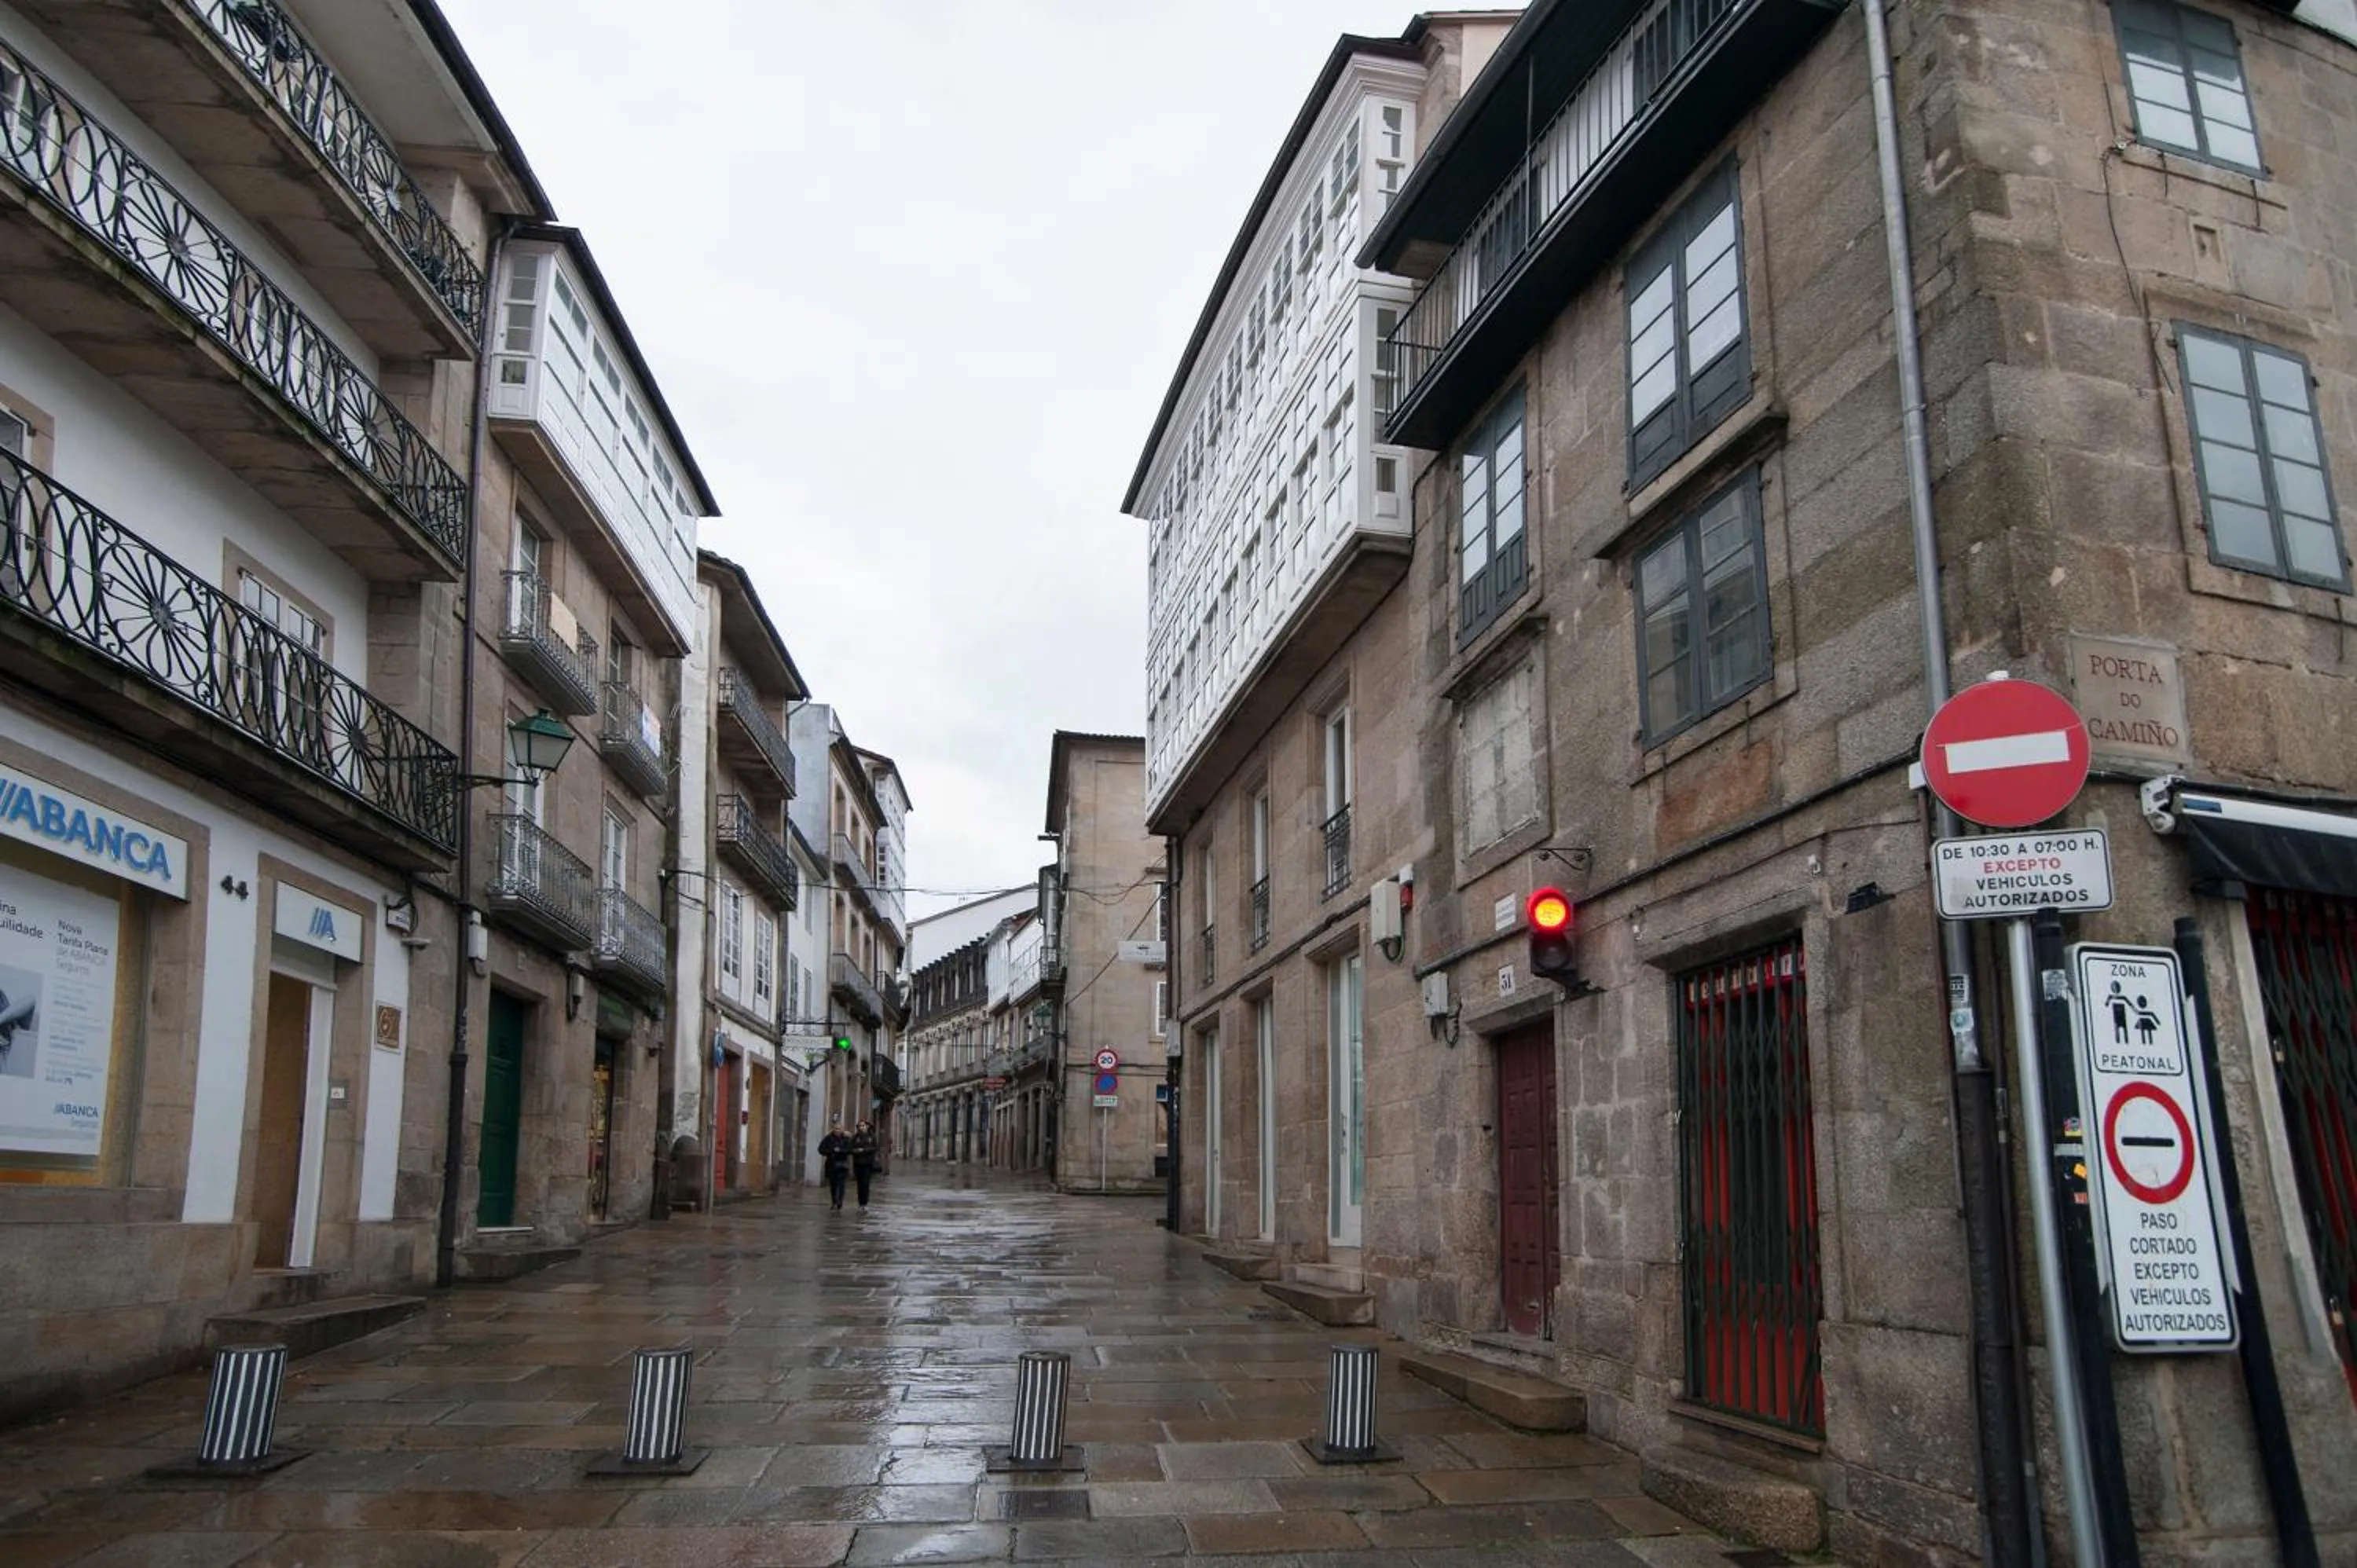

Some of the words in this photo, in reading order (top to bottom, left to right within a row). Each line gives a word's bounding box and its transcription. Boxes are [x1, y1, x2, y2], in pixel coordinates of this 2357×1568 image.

[2089, 654, 2162, 683] PORTA
[2120, 693, 2141, 709] DO
[2088, 717, 2179, 747] CAMIÑO
[7, 786, 172, 881] ABANCA
[1943, 848, 1963, 860] DE
[1970, 844, 2010, 857] 10:30
[2018, 843, 2028, 855] A
[2035, 840, 2077, 854] 07:00
[2084, 837, 2099, 850] H.
[1983, 857, 2062, 874] EXCEPTO
[221, 875, 249, 900] 44
[1976, 873, 2073, 891] VEHICULOS
[1964, 889, 2089, 908] AUTORIZADOS
[2110, 964, 2146, 977] ZONA
[2102, 1053, 2175, 1070] PEATONAL
[2140, 1212, 2178, 1229] PASO
[2130, 1237, 2197, 1255] CORTADO
[2134, 1262, 2199, 1280] EXCEPTO
[2130, 1288, 2212, 1305] VEHICULOS
[2125, 1313, 2227, 1332] AUTORIZADOS
